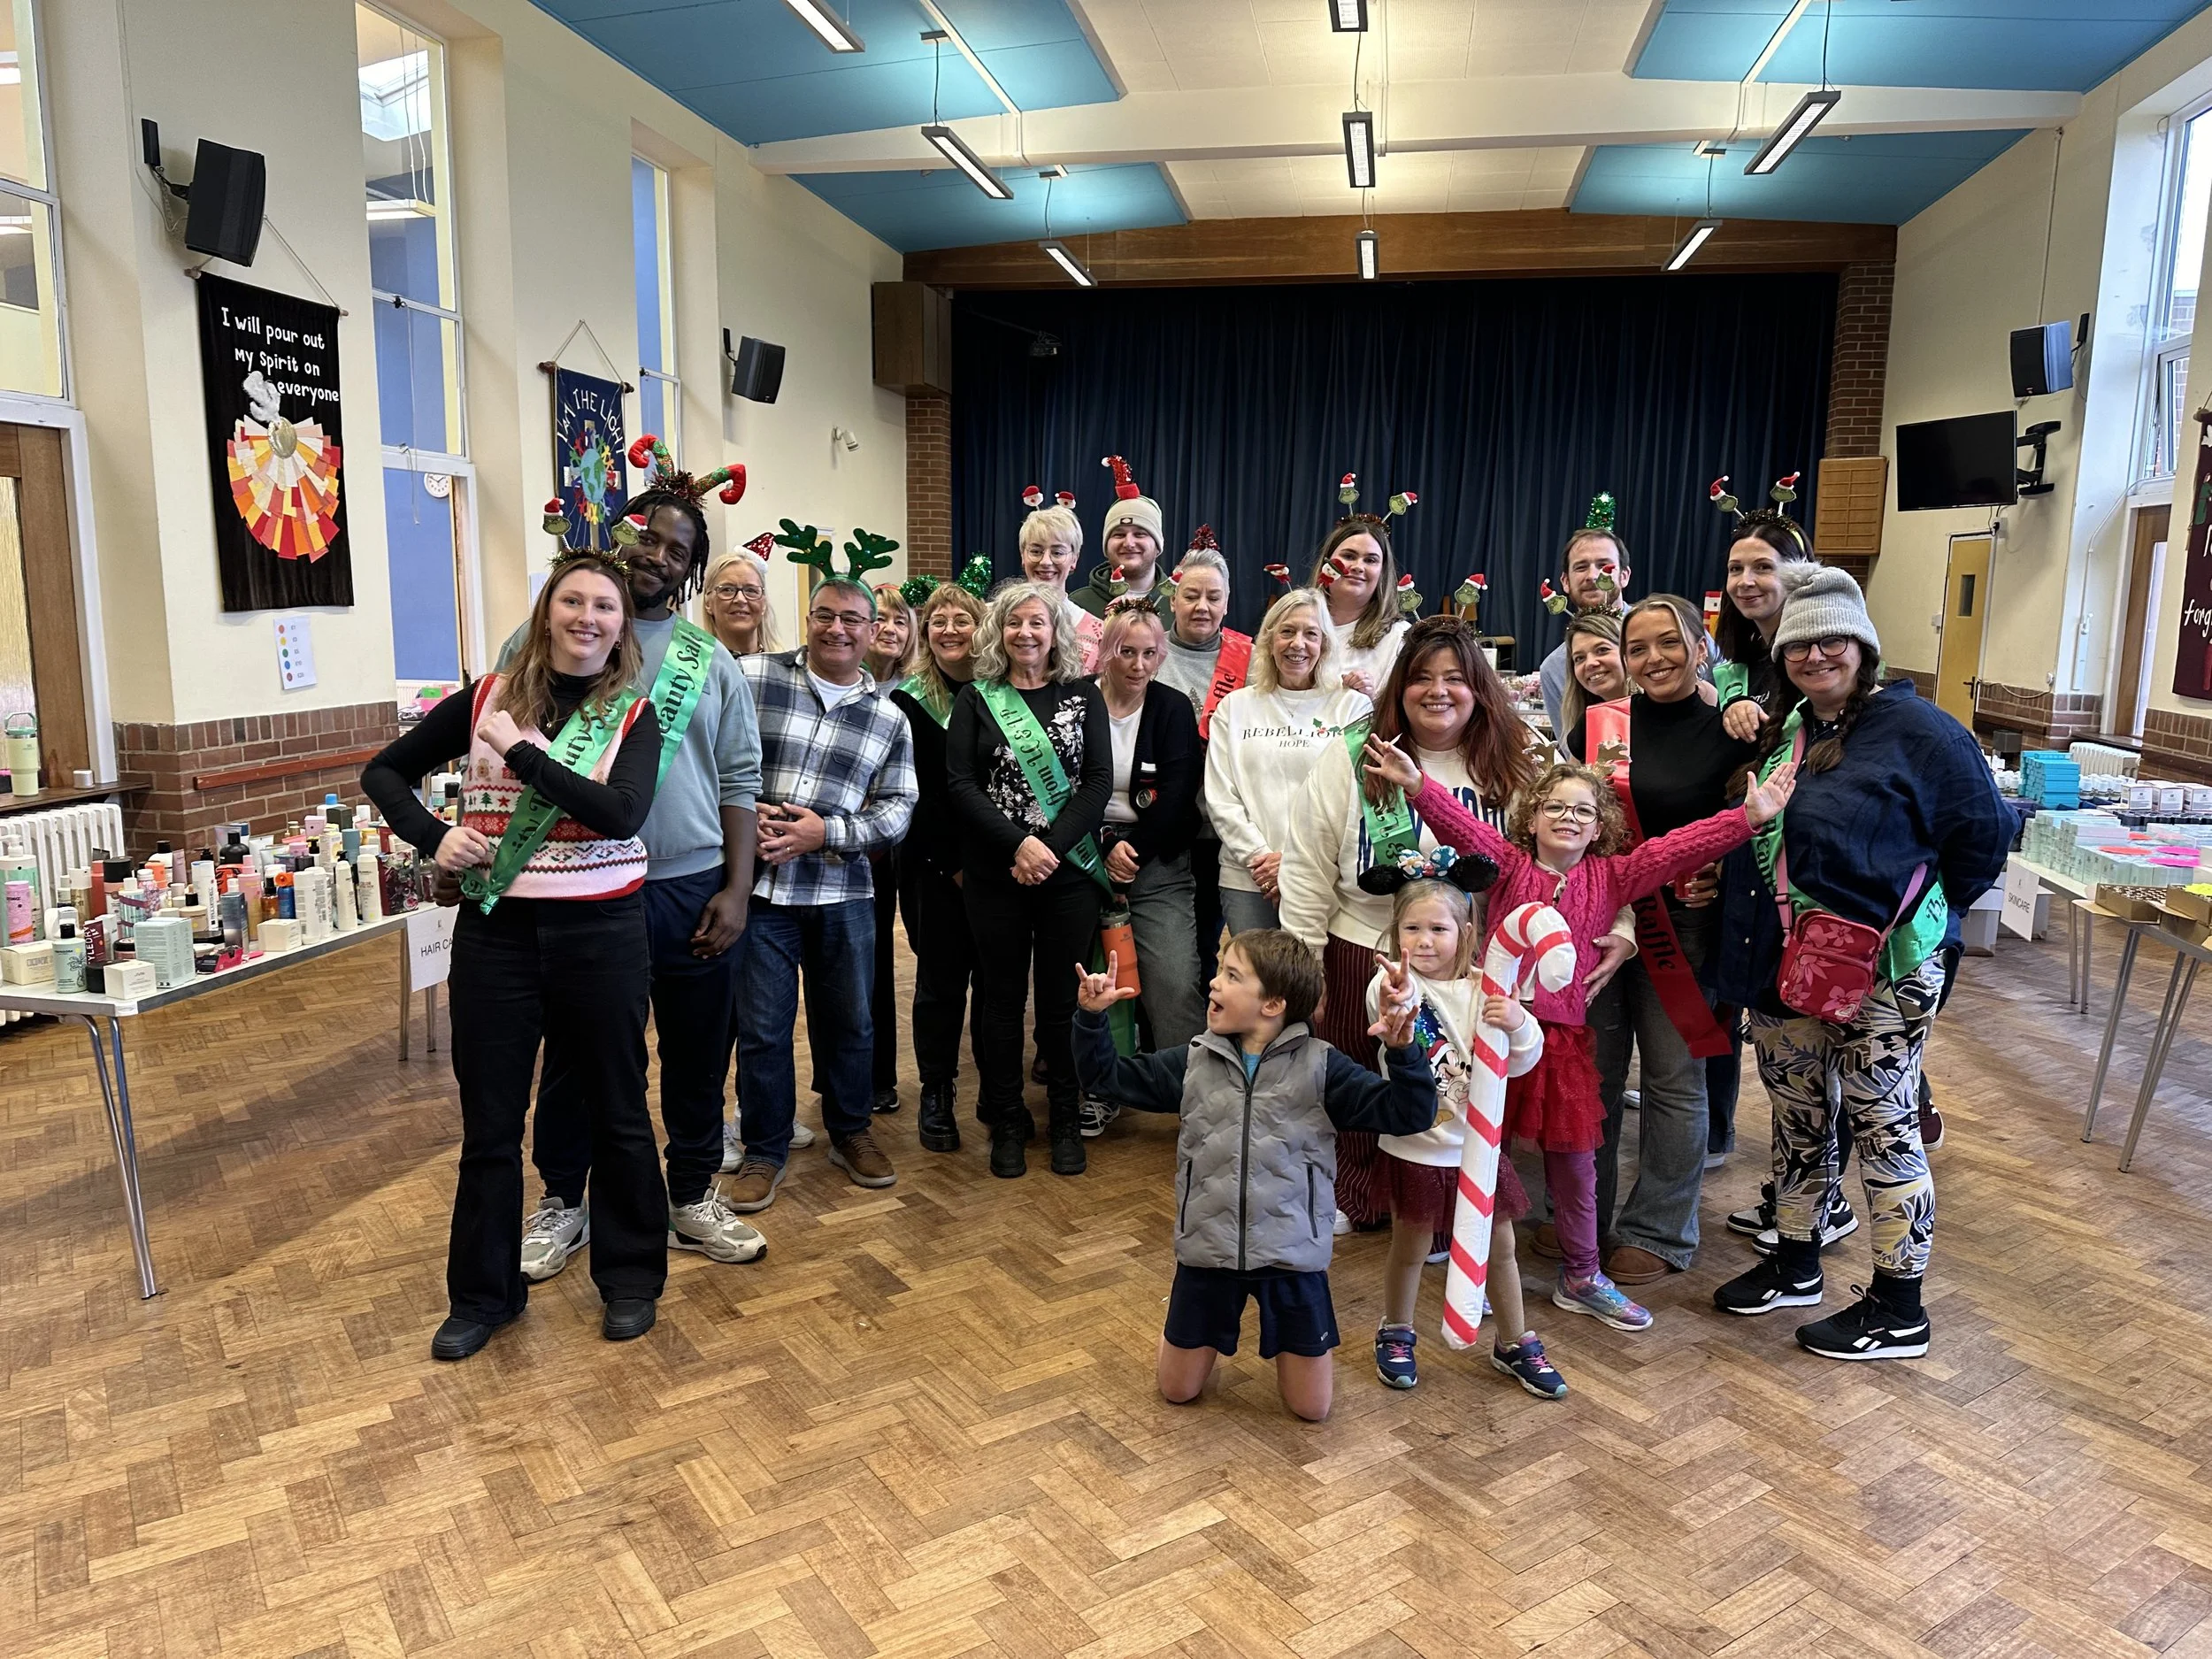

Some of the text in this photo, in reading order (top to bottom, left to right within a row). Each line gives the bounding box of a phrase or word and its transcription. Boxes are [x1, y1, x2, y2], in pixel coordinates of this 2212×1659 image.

[221, 307, 325, 349] I will pour out
[260, 351, 298, 375] Spirit
[304, 362, 320, 376] on
[277, 381, 340, 406] everyone
[572, 388, 598, 413] THE
[600, 399, 626, 455] LIGHT
[2184, 599, 2212, 638] forg
[660, 631, 703, 734] eauty Sale
[1279, 739, 1310, 749] HOPE
[1038, 764, 1071, 807] from
[2008, 893, 2031, 914] SKINCARE
[420, 938, 454, 957] HAIR CA
[1630, 895, 1678, 972] Raffle
